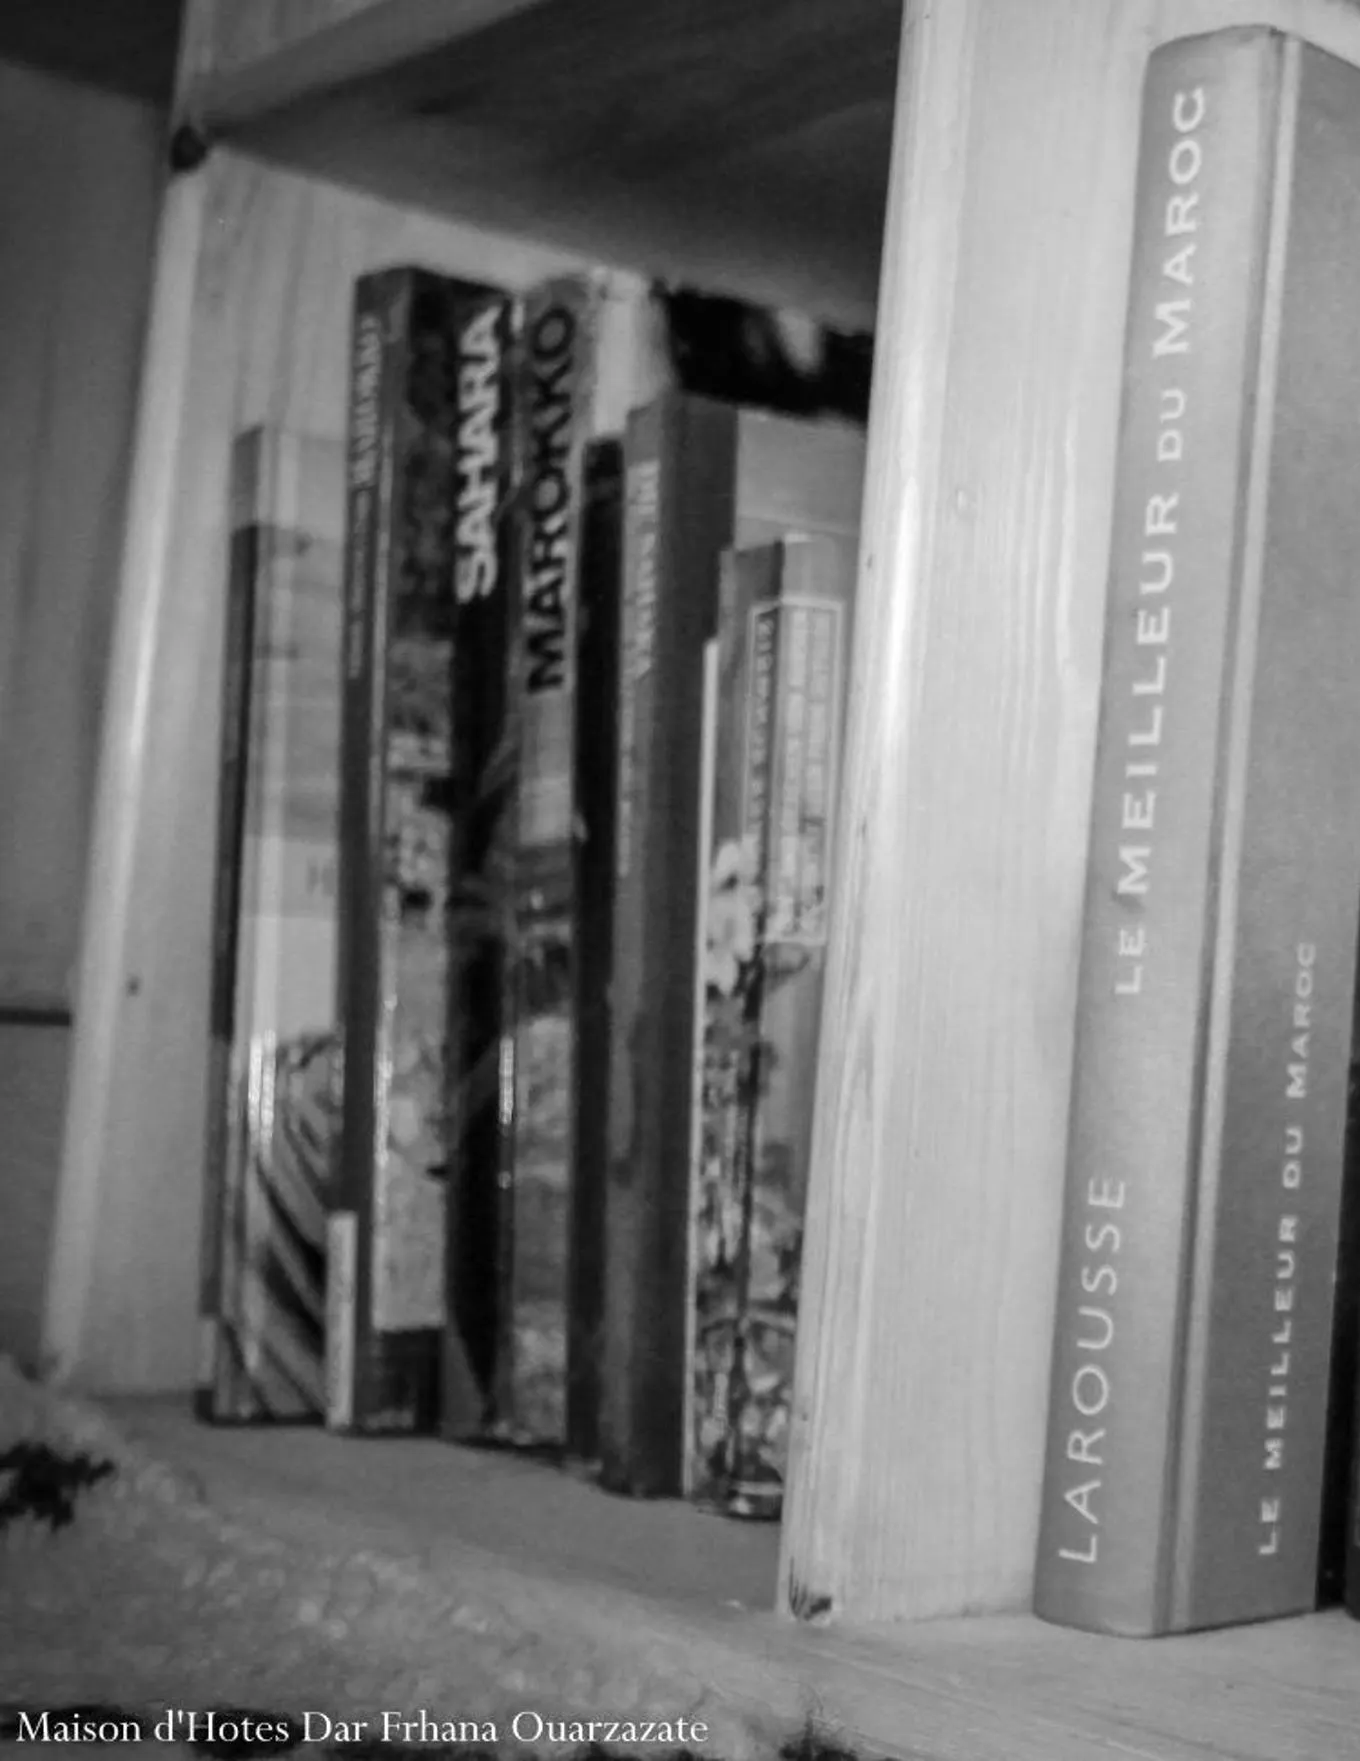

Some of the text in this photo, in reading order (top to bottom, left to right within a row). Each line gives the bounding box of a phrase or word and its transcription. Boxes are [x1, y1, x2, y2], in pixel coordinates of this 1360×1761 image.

[455, 303, 502, 604] SAHARA
[526, 305, 576, 694] MAROKKO
[1058, 85, 1207, 1564] LAROUSSE LE MEILLEUR DU MAROC
[1258, 942, 1316, 1556] LE MEILLEUR DU MAROC
